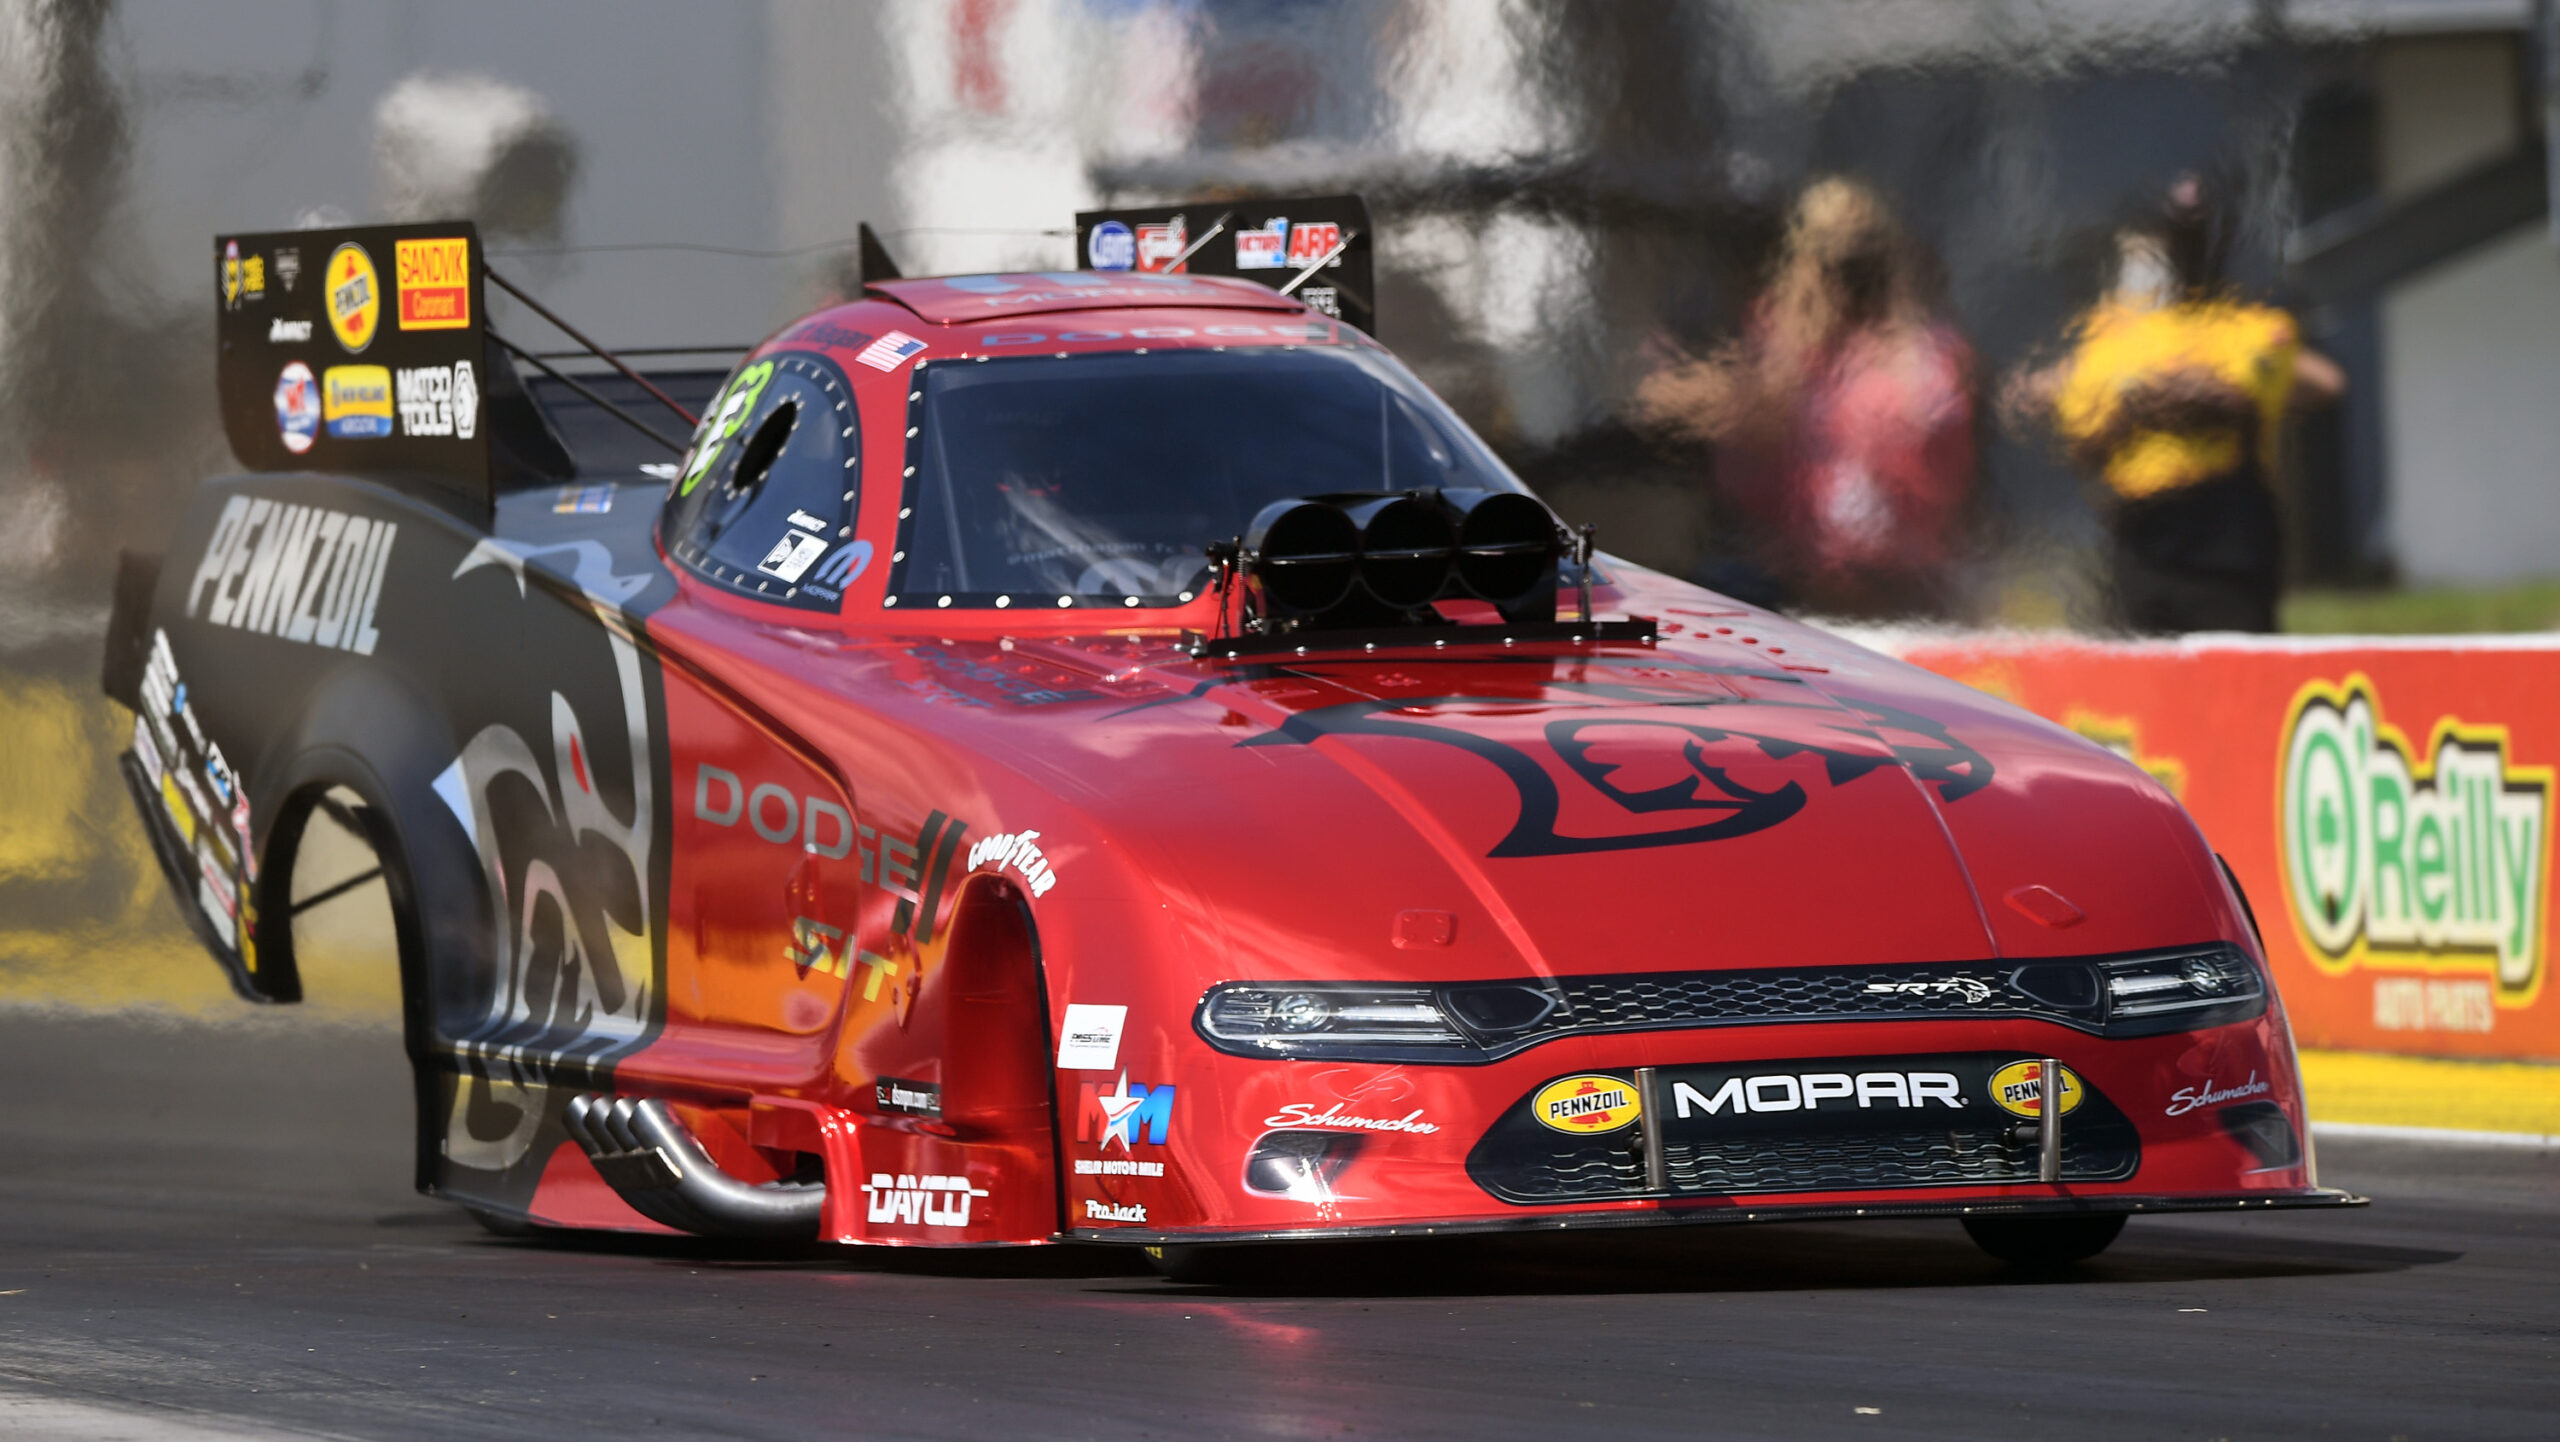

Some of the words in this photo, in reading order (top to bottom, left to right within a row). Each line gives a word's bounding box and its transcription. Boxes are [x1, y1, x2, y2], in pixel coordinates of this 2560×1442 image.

[400, 244, 465, 284] SANDVIK
[412, 290, 456, 319] Coromant
[396, 366, 452, 403] MATCO
[400, 401, 453, 437] TOOLS
[186, 494, 397, 656] PENNZOIL
[2297, 706, 2540, 968] O'Reilly
[1861, 982, 1960, 996] SRT
[1549, 1088, 1631, 1121] PENNZOIL
[1672, 1071, 1965, 1119] MOPAR
[2003, 1075, 2071, 1104] PENNL
[2164, 1069, 2269, 1117] Schumacher
[1264, 1102, 1440, 1136] Schumacher
[1103, 1160, 1137, 1176] MOTOR
[867, 1172, 973, 1228] DAYCO
